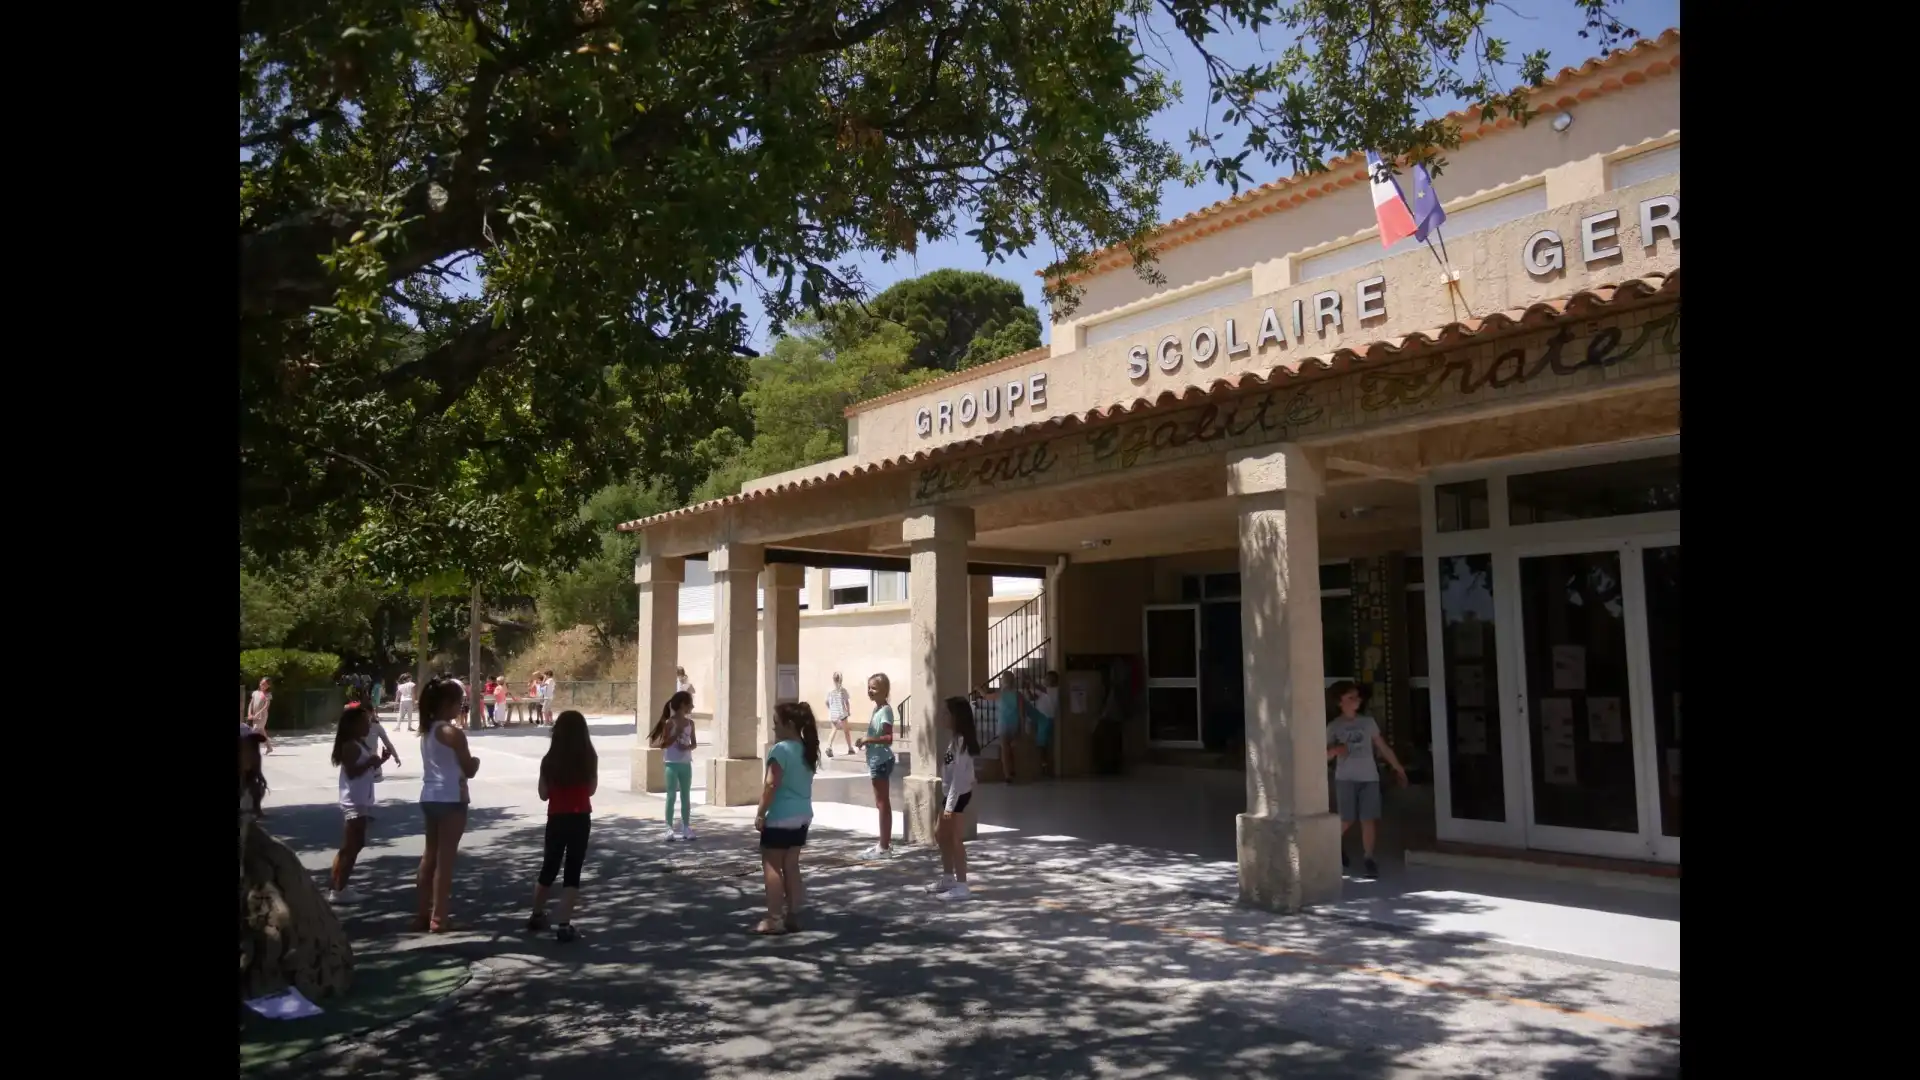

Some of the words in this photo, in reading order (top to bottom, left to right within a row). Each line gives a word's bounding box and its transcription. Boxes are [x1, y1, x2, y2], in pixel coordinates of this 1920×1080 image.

[915, 373, 1047, 436] GROUPE
[1127, 275, 1386, 380] SCOLAIRE
[1523, 194, 1680, 276] GER
